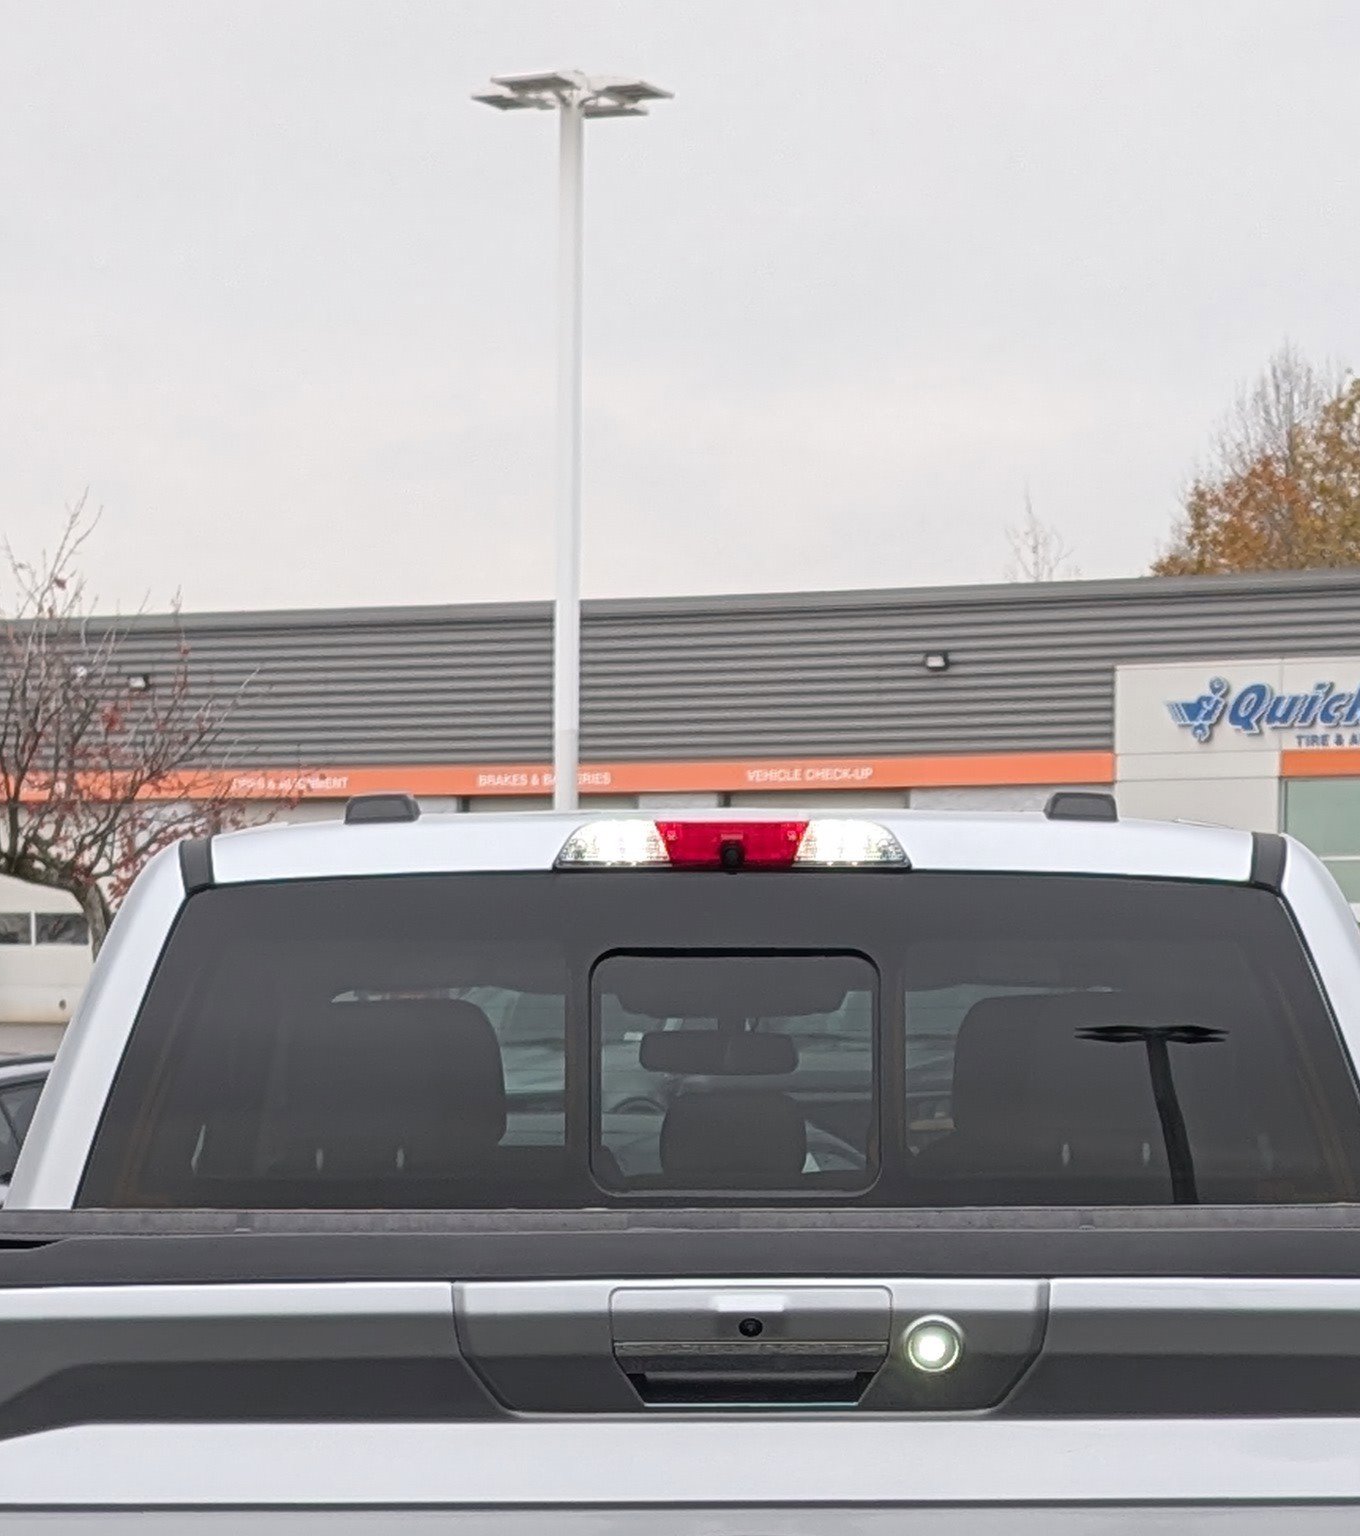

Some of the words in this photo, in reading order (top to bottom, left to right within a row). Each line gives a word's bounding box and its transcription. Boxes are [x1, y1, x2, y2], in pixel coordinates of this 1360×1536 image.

[1296, 733, 1330, 748] TIRE
[1334, 733, 1345, 747] &
[478, 773, 528, 787] BRAKES
[746, 768, 802, 782] VEHICLE
